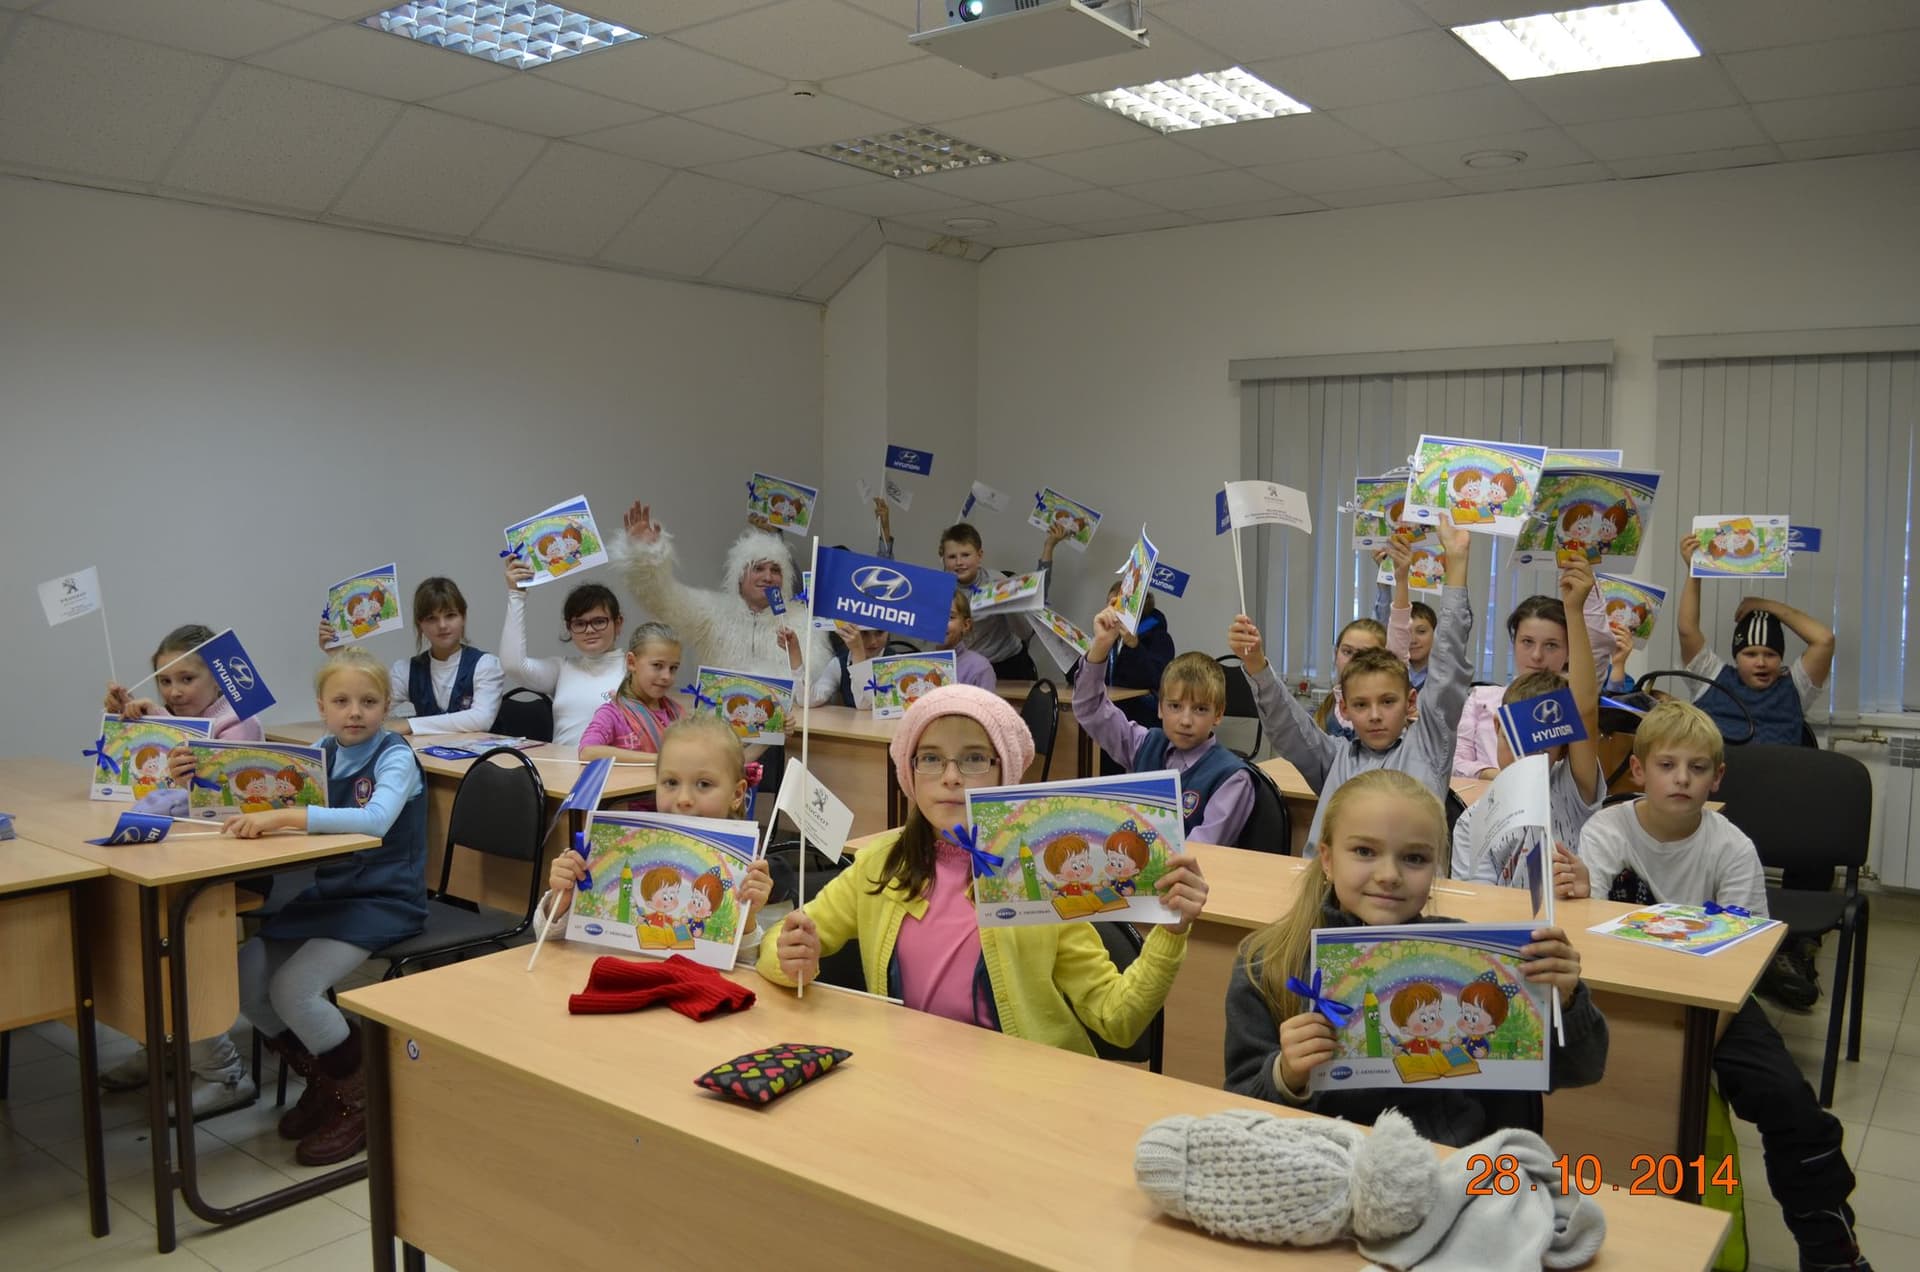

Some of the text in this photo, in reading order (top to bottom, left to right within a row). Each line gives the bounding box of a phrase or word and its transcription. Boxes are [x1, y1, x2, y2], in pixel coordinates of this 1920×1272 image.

[893, 460, 920, 471] HYUNDAI
[1152, 578, 1175, 591] YUNDAI
[836, 597, 916, 626] HYUNDAI
[213, 659, 242, 702] HYUNDAI
[1531, 724, 1574, 743] HYUNDAI
[804, 803, 829, 826] EUGEOT
